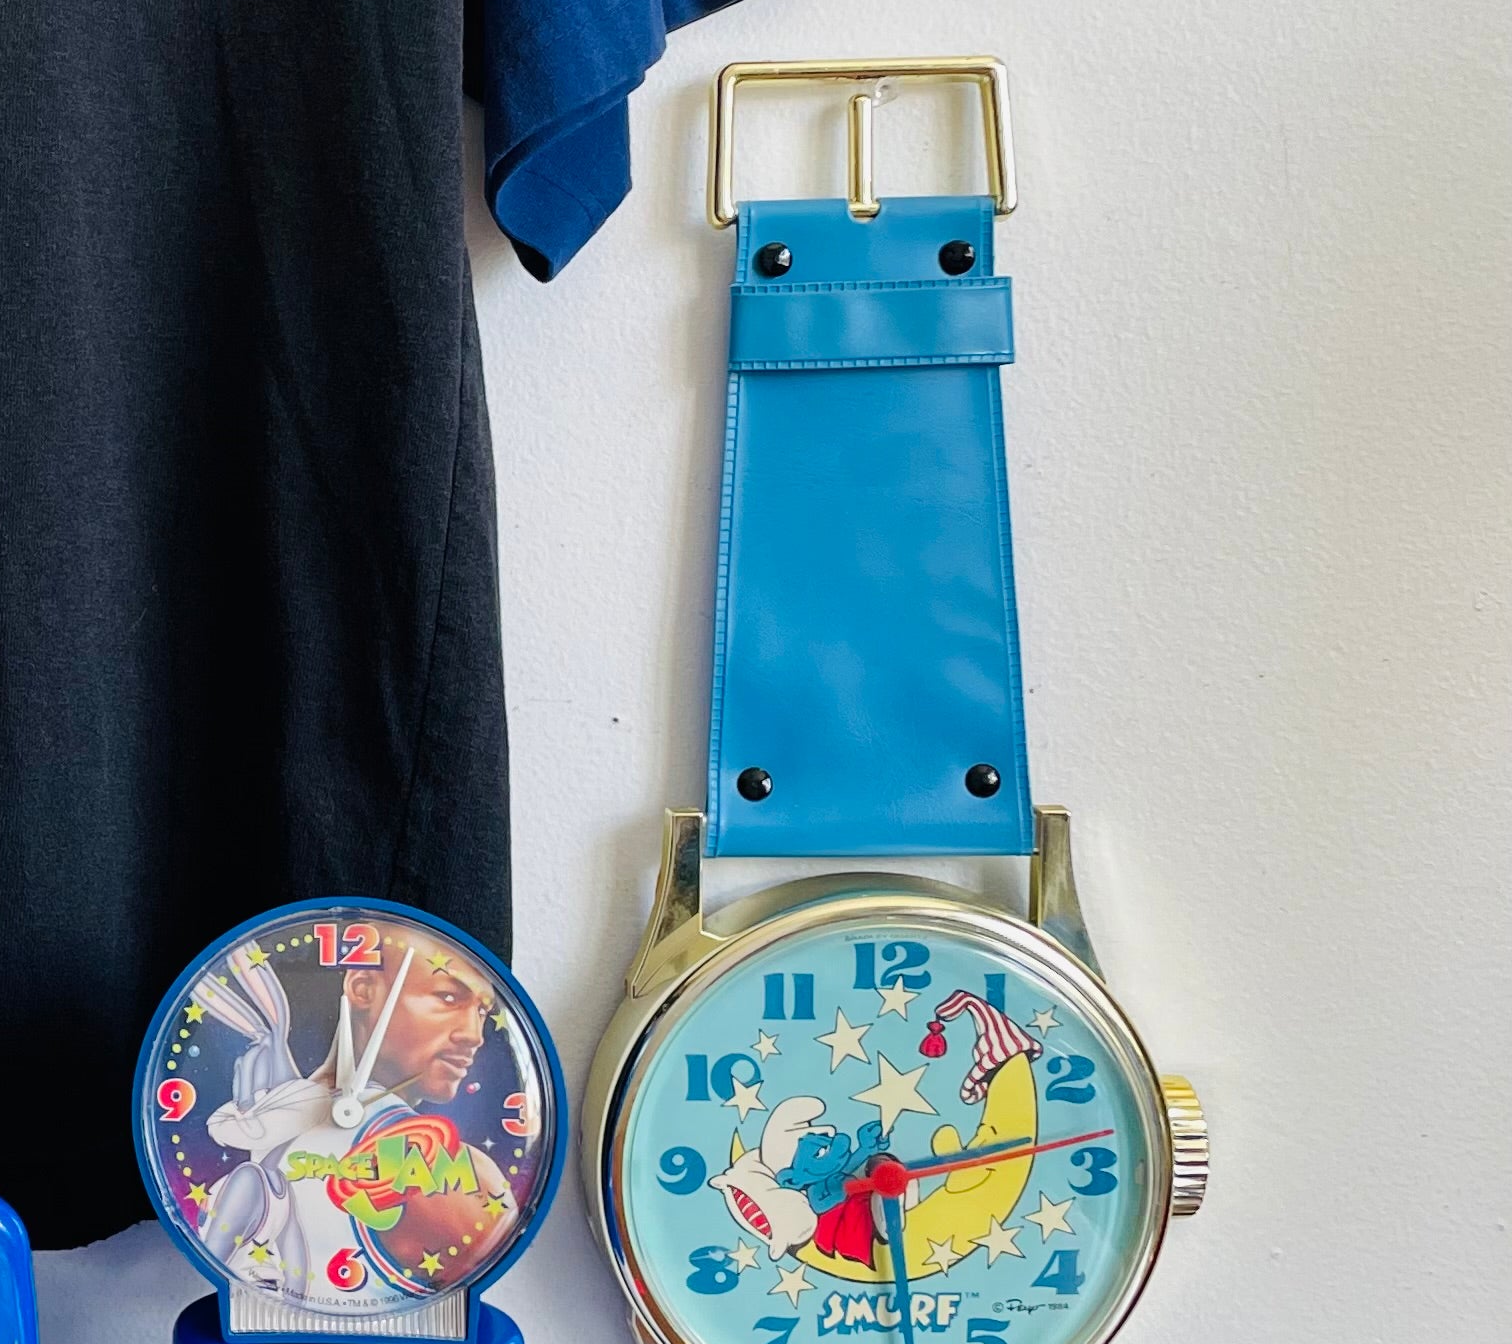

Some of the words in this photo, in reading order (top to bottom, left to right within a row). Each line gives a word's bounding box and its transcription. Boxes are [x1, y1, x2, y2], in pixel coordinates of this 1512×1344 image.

[314, 923, 384, 970] 12
[853, 940, 932, 990] 12
[762, 972, 816, 1021] 11
[984, 973, 1006, 1014] 1
[157, 1078, 196, 1122] 9
[684, 1052, 762, 1102] 10
[1045, 1054, 1097, 1105] 2
[501, 1092, 538, 1137] 3
[286, 1149, 378, 1182] SPACE
[341, 1134, 481, 1232] JAM
[656, 1144, 707, 1195] 9
[1068, 1146, 1118, 1196] 3
[325, 1247, 368, 1291] 6
[686, 1245, 740, 1295] 8
[1031, 1248, 1087, 1295] 4
[819, 1290, 963, 1337] SMURF
